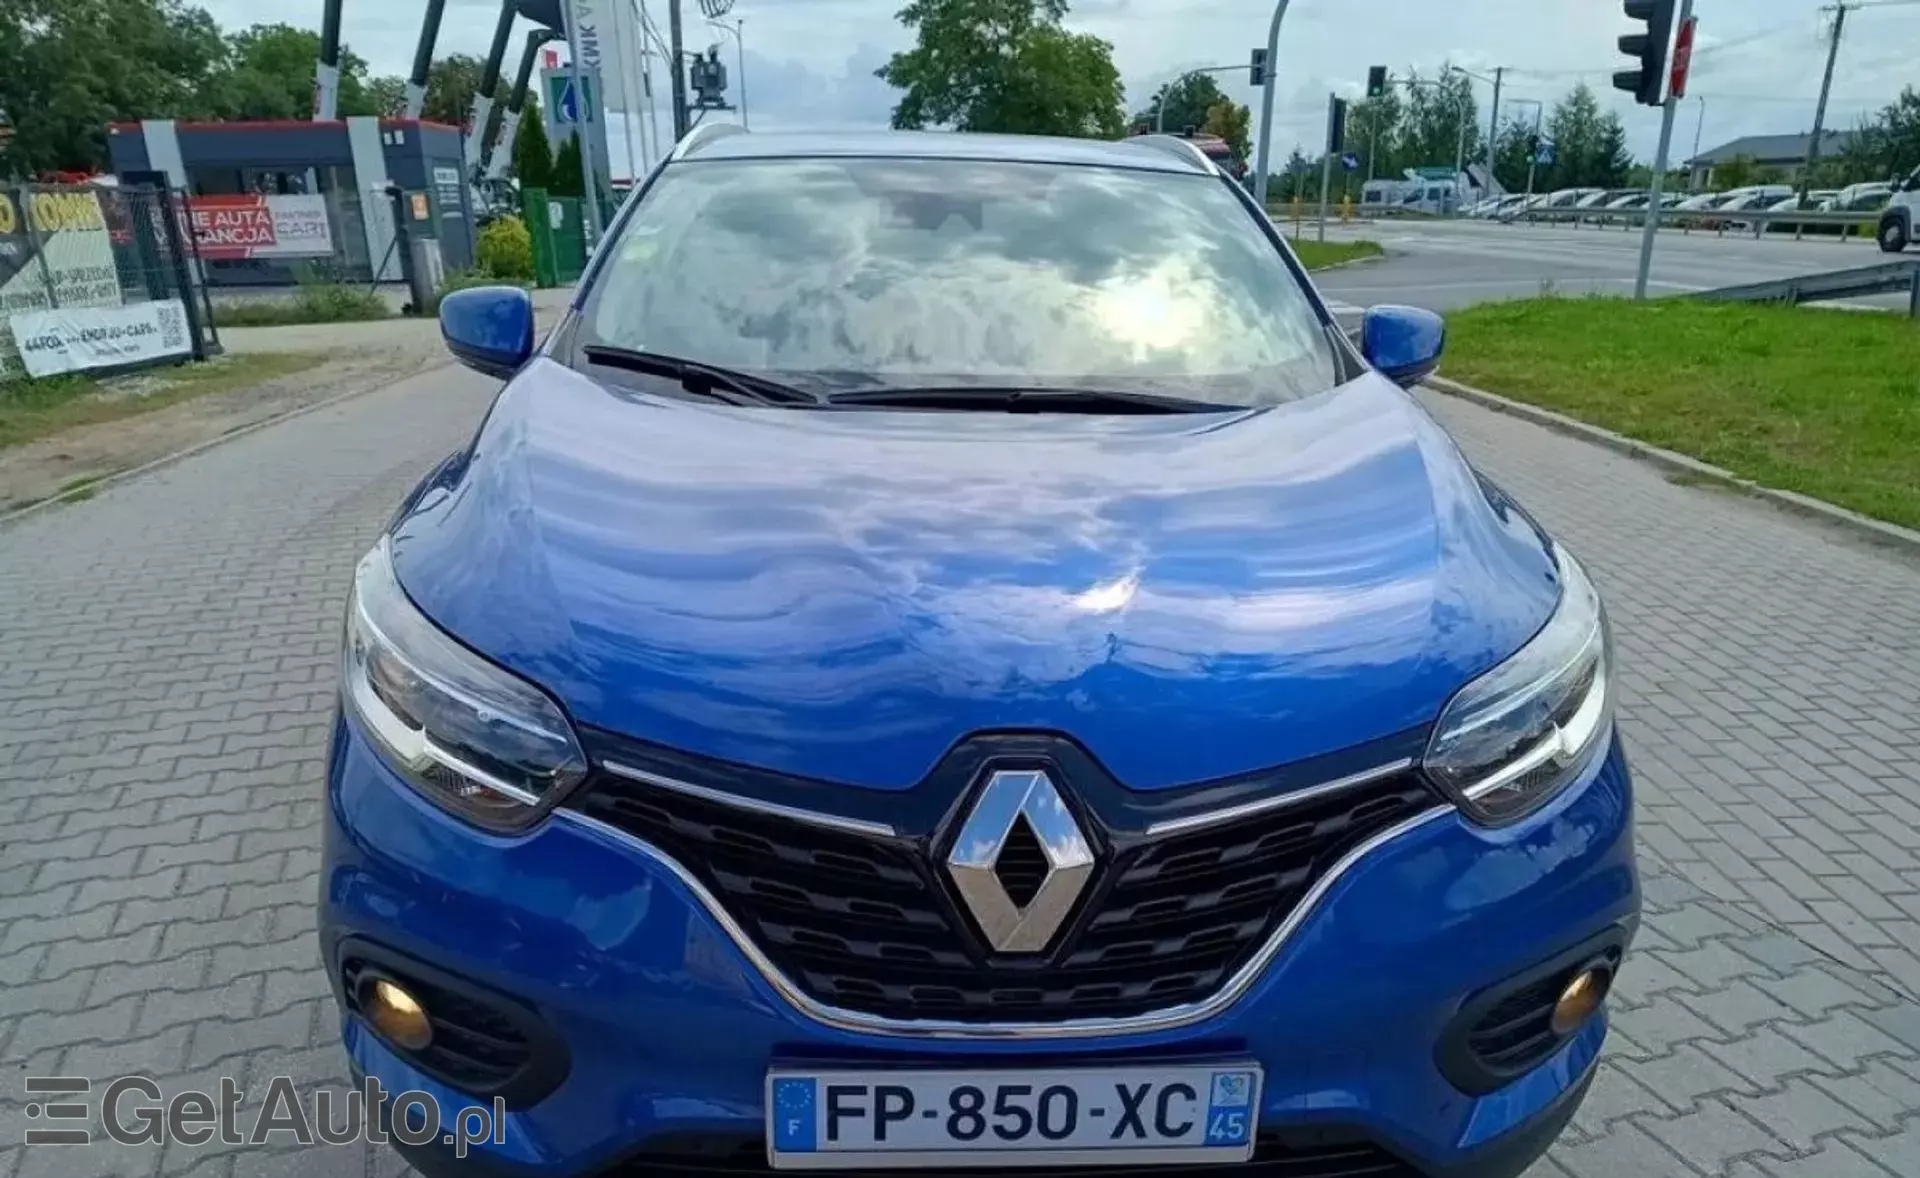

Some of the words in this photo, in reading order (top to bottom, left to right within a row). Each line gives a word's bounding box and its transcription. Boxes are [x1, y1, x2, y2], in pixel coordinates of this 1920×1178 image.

[214, 209, 270, 226] AUTA
[825, 1082, 1197, 1142] FP-850-XC
[787, 1119, 800, 1137] F
[1209, 1111, 1245, 1139] 45
